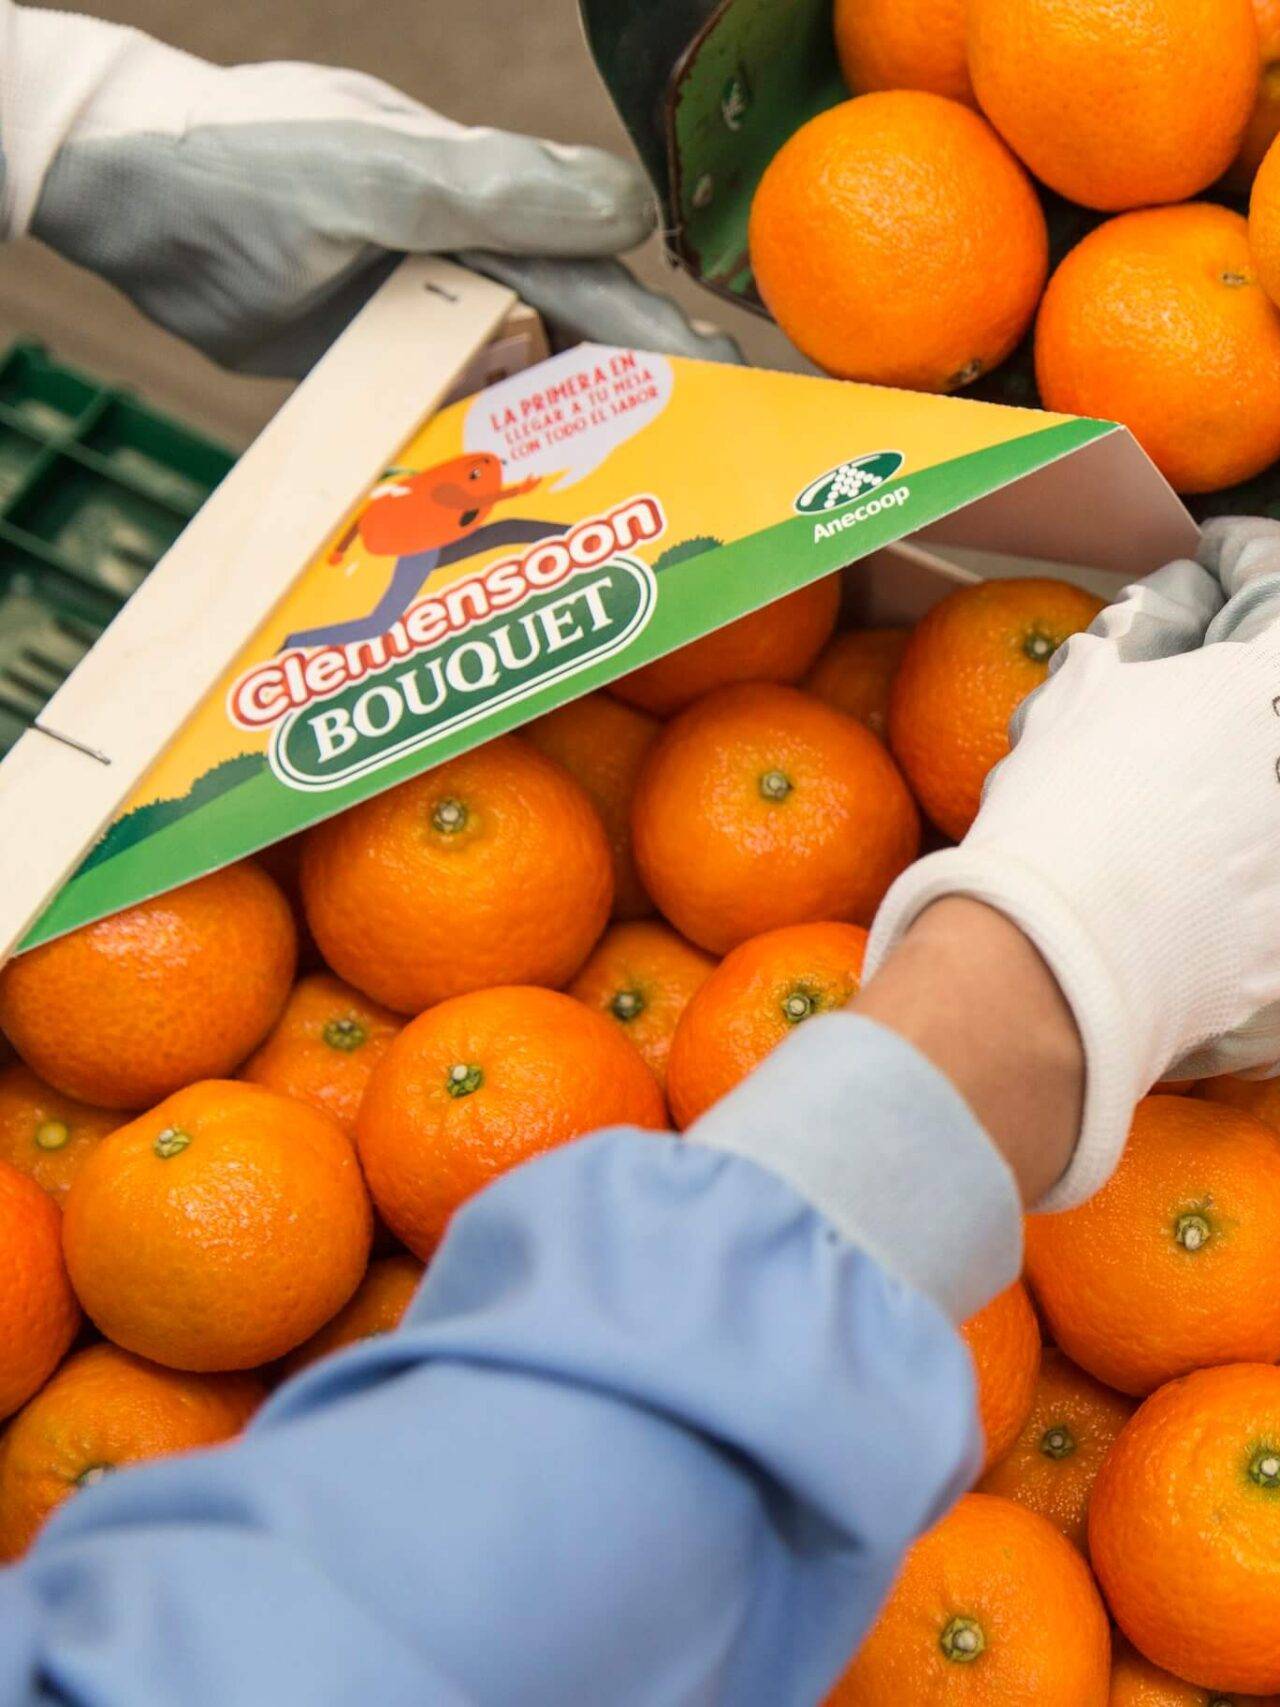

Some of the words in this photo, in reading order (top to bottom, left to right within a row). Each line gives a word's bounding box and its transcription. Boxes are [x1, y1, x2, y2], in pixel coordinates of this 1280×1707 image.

[490, 407, 516, 431] LA
[519, 367, 606, 416] PRIMERA
[609, 351, 637, 376] EN
[504, 409, 564, 444] LLEGAR
[571, 402, 581, 414] A
[588, 387, 608, 405] TU
[511, 440, 541, 460] CON
[545, 420, 587, 445] TODO
[591, 410, 607, 425] EL
[611, 386, 658, 415] SABOR
[814, 486, 910, 544] Anecoop
[232, 498, 661, 727] Clemensoon
[307, 577, 613, 763] BOUQUET
